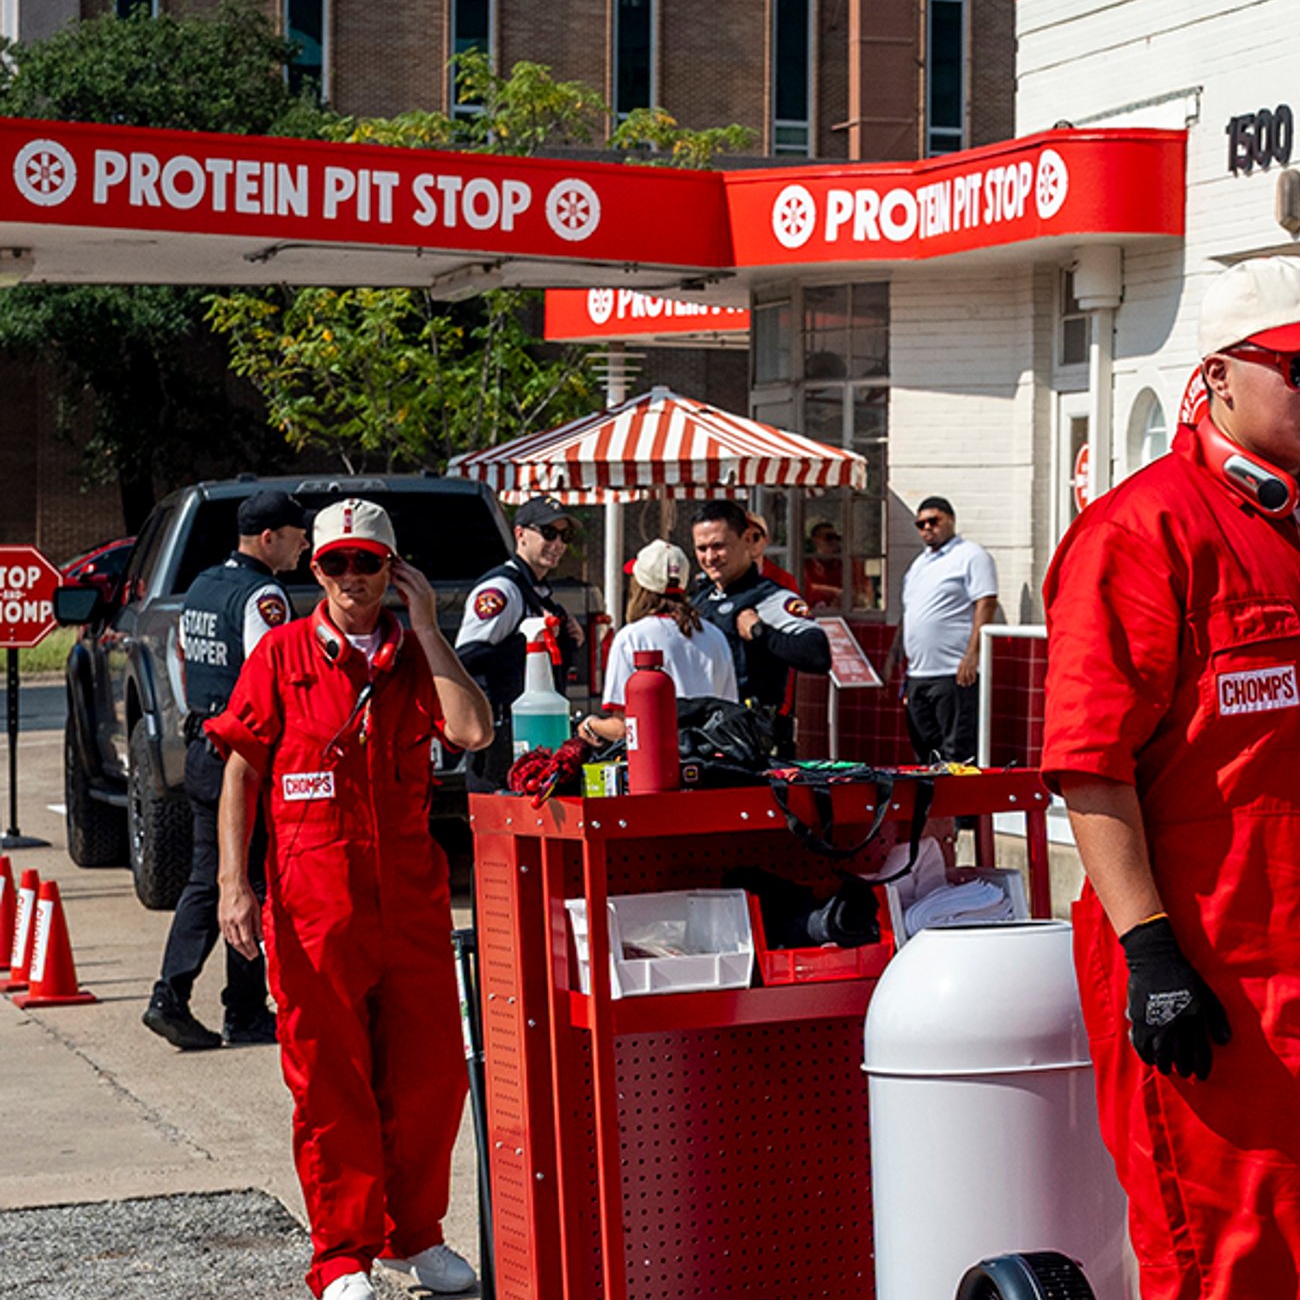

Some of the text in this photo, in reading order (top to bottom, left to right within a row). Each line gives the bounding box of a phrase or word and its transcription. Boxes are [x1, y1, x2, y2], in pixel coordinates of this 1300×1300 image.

[1226, 104, 1294, 177] 1500
[94, 149, 532, 232] PROTEIN PIT STOP
[825, 161, 1033, 241] PROTEIN PIT STOP
[0, 565, 42, 590] TOP
[0, 599, 53, 624] OMP
[185, 608, 218, 638] STATE
[184, 636, 228, 666] OOPER
[1222, 671, 1295, 707] CHOMPS
